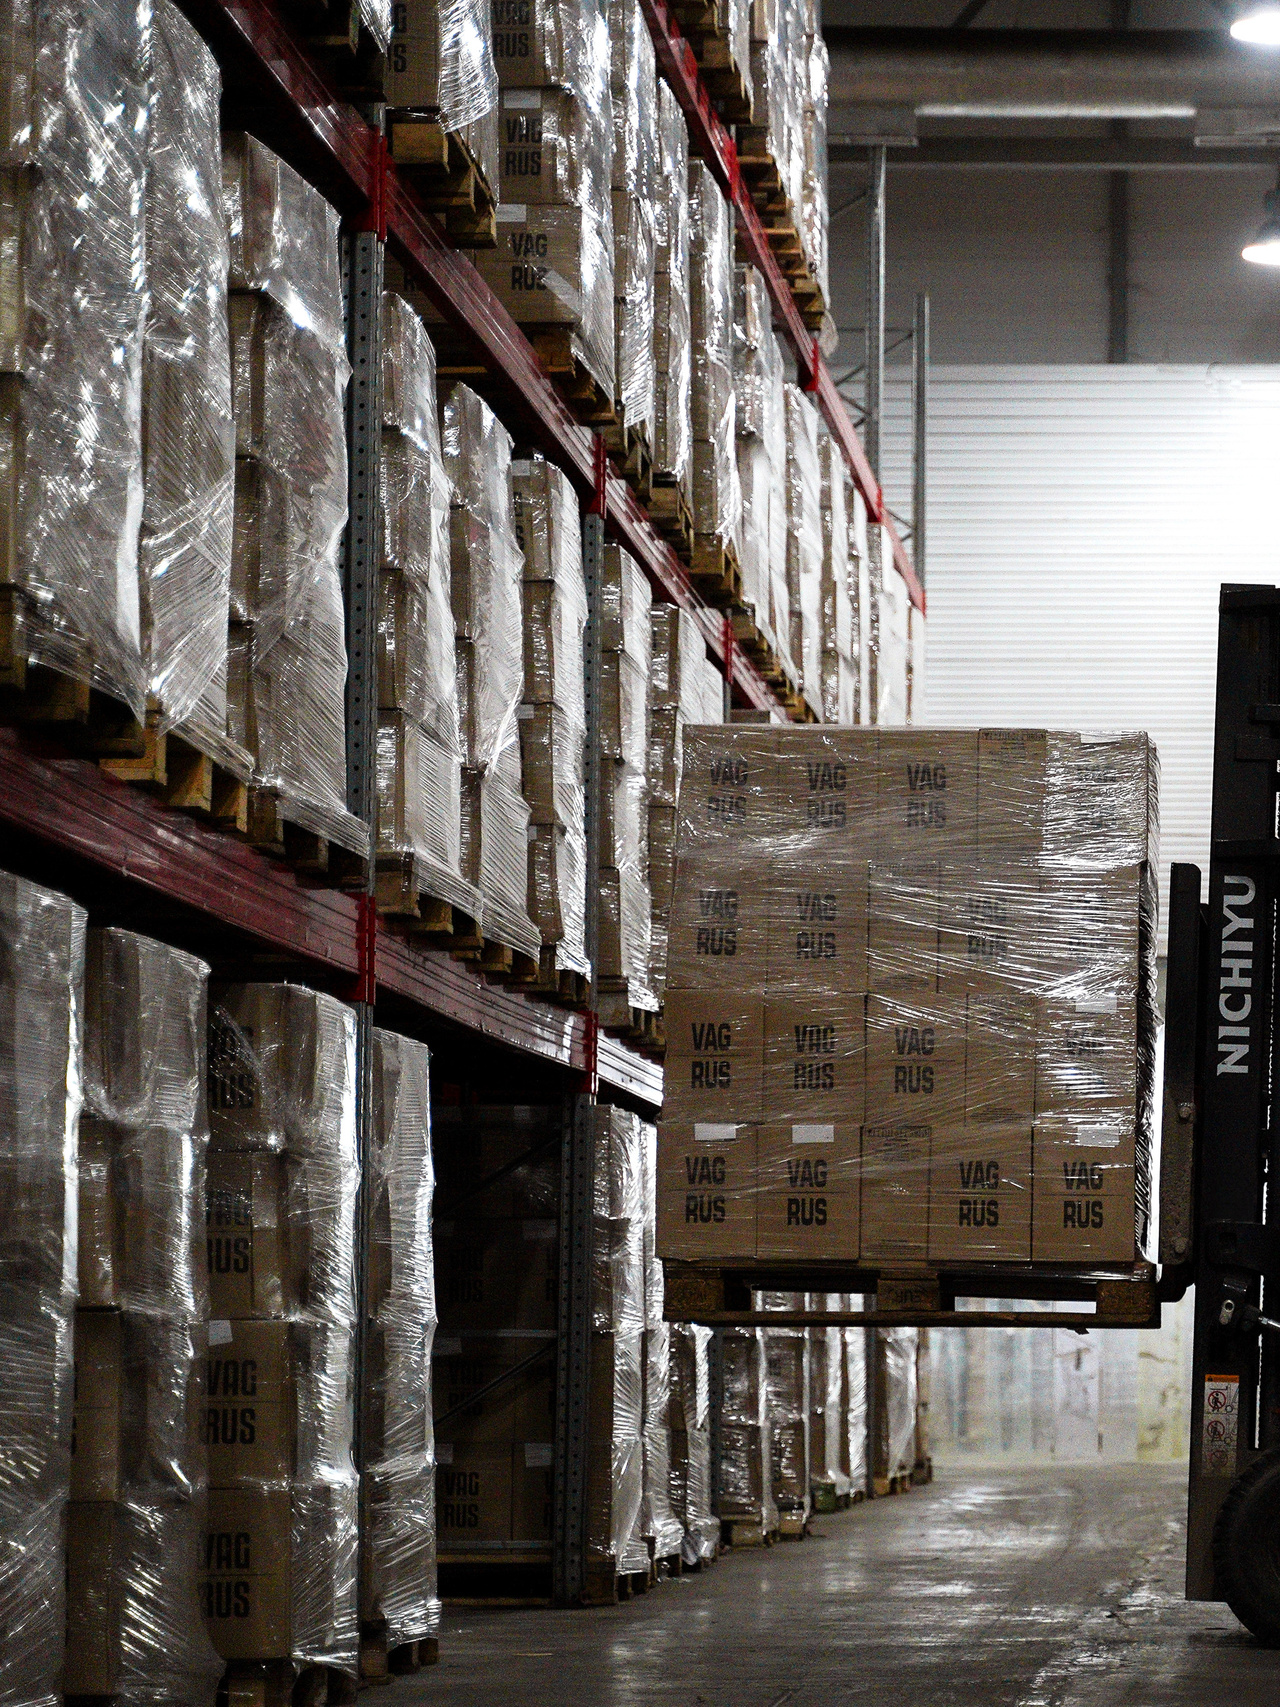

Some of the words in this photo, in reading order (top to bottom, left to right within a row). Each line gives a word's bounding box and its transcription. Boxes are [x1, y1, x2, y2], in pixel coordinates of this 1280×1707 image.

[506, 118, 542, 144] VAG
[505, 151, 541, 176] RUS
[512, 233, 548, 257] VAG
[511, 266, 548, 291] RUS
[710, 758, 749, 786] VAG
[807, 762, 847, 790] VAG
[907, 762, 947, 790] VAG
[807, 800, 847, 828] RUS
[907, 800, 947, 828] RUS
[699, 890, 738, 919] VAG
[797, 893, 837, 921] VAG
[697, 927, 737, 956] RUS
[796, 932, 837, 960] RUS
[1217, 875, 1256, 1076] NICHIYU
[691, 1023, 731, 1050] VAG
[795, 1024, 835, 1054] VAG
[894, 1027, 934, 1056] VAG
[691, 1061, 731, 1089] RUS
[794, 1062, 835, 1090] RUS
[894, 1065, 934, 1094] RUS
[685, 1156, 726, 1185] VAG
[787, 1159, 828, 1188] VAG
[959, 1161, 1000, 1190] VAG
[1063, 1161, 1104, 1190] VAG
[685, 1195, 726, 1224] RUS
[787, 1198, 828, 1226] RUS
[959, 1199, 1000, 1227] RUS
[1063, 1200, 1104, 1229] RUS
[443, 1472, 480, 1496] VAG
[443, 1504, 480, 1528] RUS
